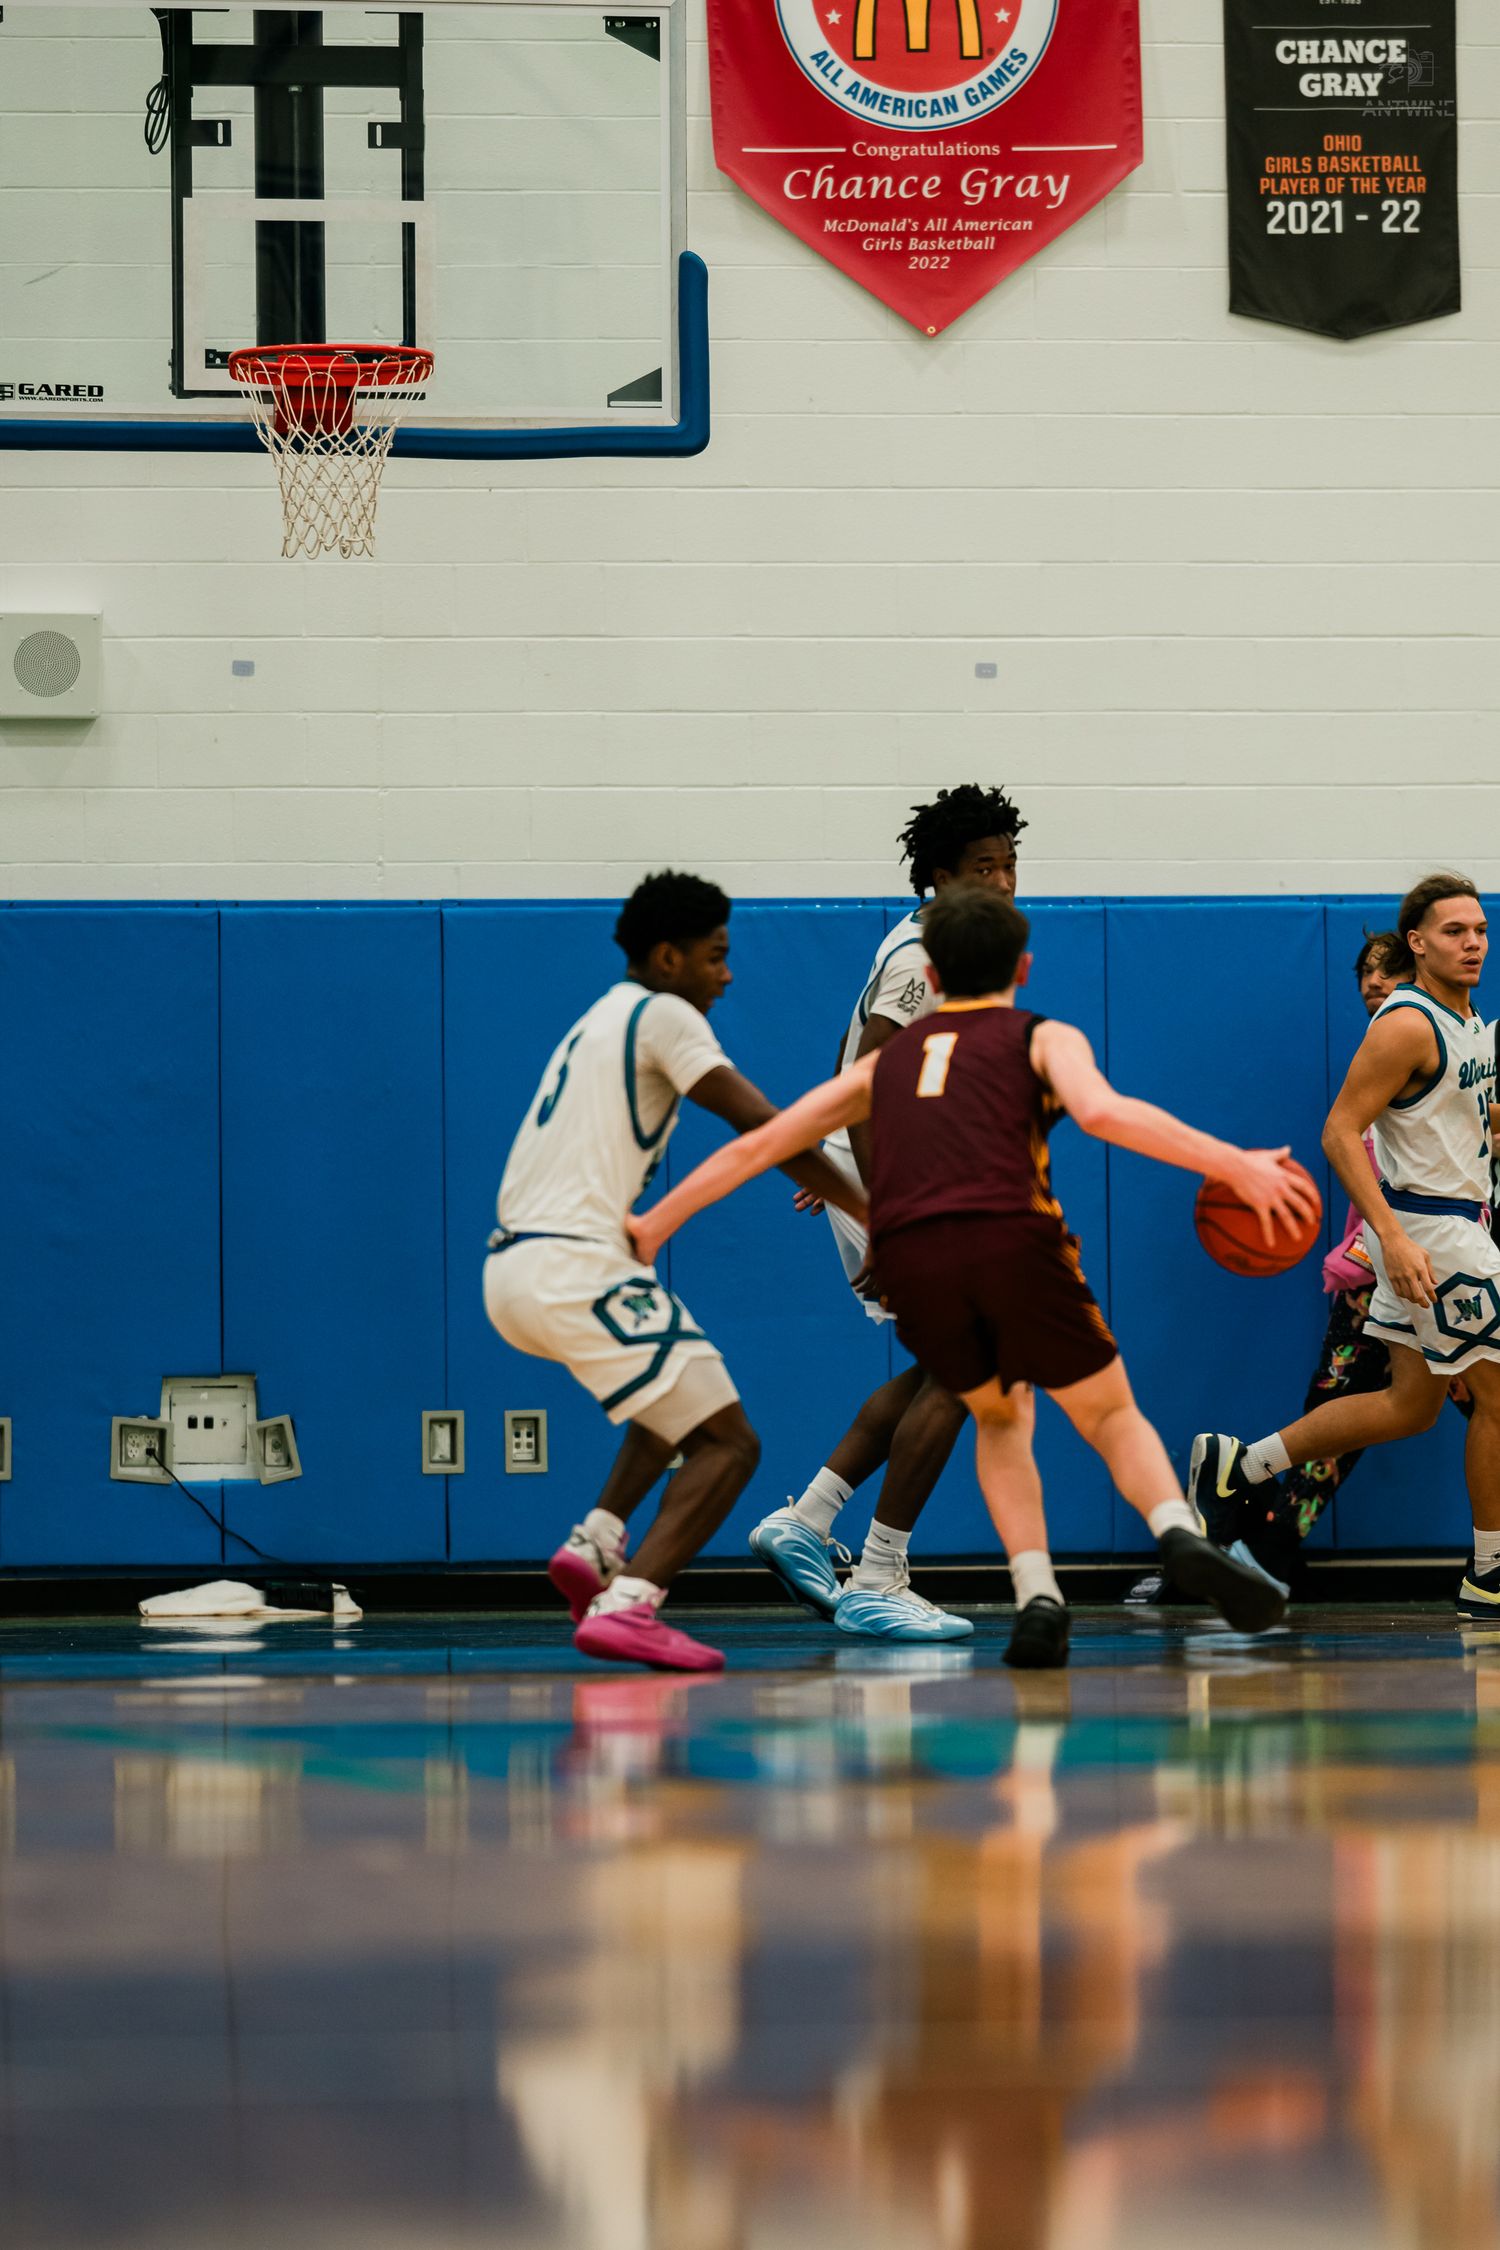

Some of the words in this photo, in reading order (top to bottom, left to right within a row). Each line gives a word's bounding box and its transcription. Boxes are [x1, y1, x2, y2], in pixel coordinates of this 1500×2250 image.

[1275, 39, 1406, 64] CHANCE
[810, 50, 844, 87] ALL
[845, 80, 959, 119] AMERICAN
[964, 48, 1029, 107] GAMES
[1299, 73, 1383, 98] GRAY
[852, 141, 1001, 161] Congratulations
[1323, 134, 1362, 152] OHIO
[1265, 156, 1312, 174] GIRLS
[1317, 155, 1421, 173] BASKETBALL
[783, 165, 942, 200] Chance
[960, 167, 1071, 210] Gray
[1259, 178, 1320, 195] PLAYER
[1325, 177, 1345, 194] OF
[1350, 177, 1380, 194] THE
[1385, 176, 1427, 194] YEAR
[823, 218, 919, 233] McDonald's
[924, 217, 947, 232] All
[953, 218, 1033, 231] American
[1266, 200, 1343, 235] 2021
[1381, 200, 1421, 233] 22
[862, 238, 903, 252] Girls
[908, 237, 996, 251] Basketball
[908, 255, 951, 270] 2022
[18, 383, 104, 397] GARED
[916, 1031, 959, 1098] 1
